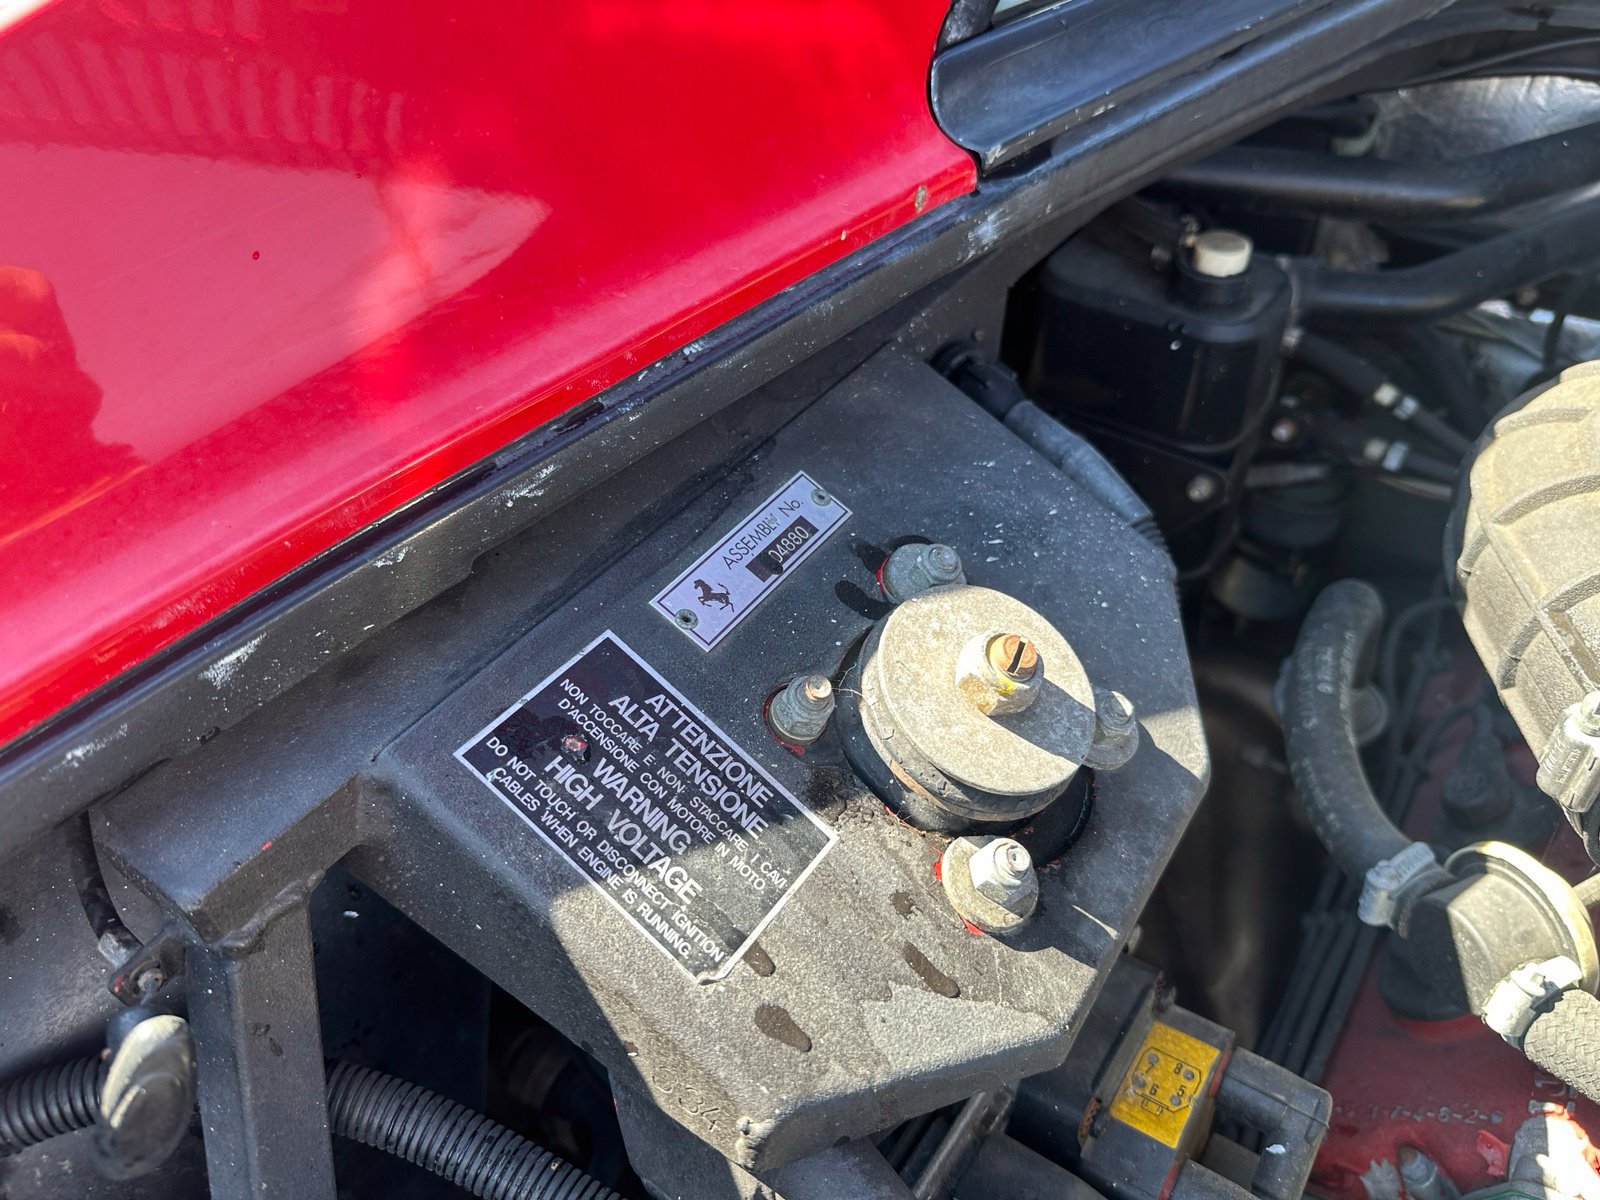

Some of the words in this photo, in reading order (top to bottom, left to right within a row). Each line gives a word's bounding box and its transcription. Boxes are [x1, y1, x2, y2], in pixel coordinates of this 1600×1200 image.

[768, 526, 810, 563] 04880
[778, 498, 804, 518] No.
[556, 697, 640, 773] D'ACCENSIONE
[637, 770, 668, 799] CON
[665, 797, 717, 844] MOTORE
[713, 841, 730, 857] IN
[728, 855, 770, 894] MOTO.
[559, 678, 589, 705] NON
[586, 703, 643, 754] TOCCARE
[642, 753, 656, 766] E
[655, 766, 685, 793] NON
[687, 795, 750, 852] STACCARE
[587, 757, 694, 855] WARNING
[607, 691, 665, 742] ALTA
[658, 737, 770, 839] TENSIONE
[643, 689, 775, 808] ATTENZIONE
[484, 736, 510, 758] DO
[506, 755, 537, 783] NOT
[531, 779, 577, 821] TOUCH
[573, 818, 598, 841] OR
[595, 839, 671, 910] DISCONNECT
[669, 909, 725, 962] IGNITION
[491, 766, 542, 812] CABLES
[538, 810, 579, 848] WHEN
[576, 845, 624, 890] ENGINE
[621, 887, 639, 905] IS
[634, 901, 696, 959] RUNNING.
[543, 754, 605, 811] HIGH
[599, 807, 706, 905] VOLTAGE
[1149, 1083, 1159, 1096] 6
[1177, 1084, 1187, 1097] 5
[1173, 1062, 1183, 1075] 8
